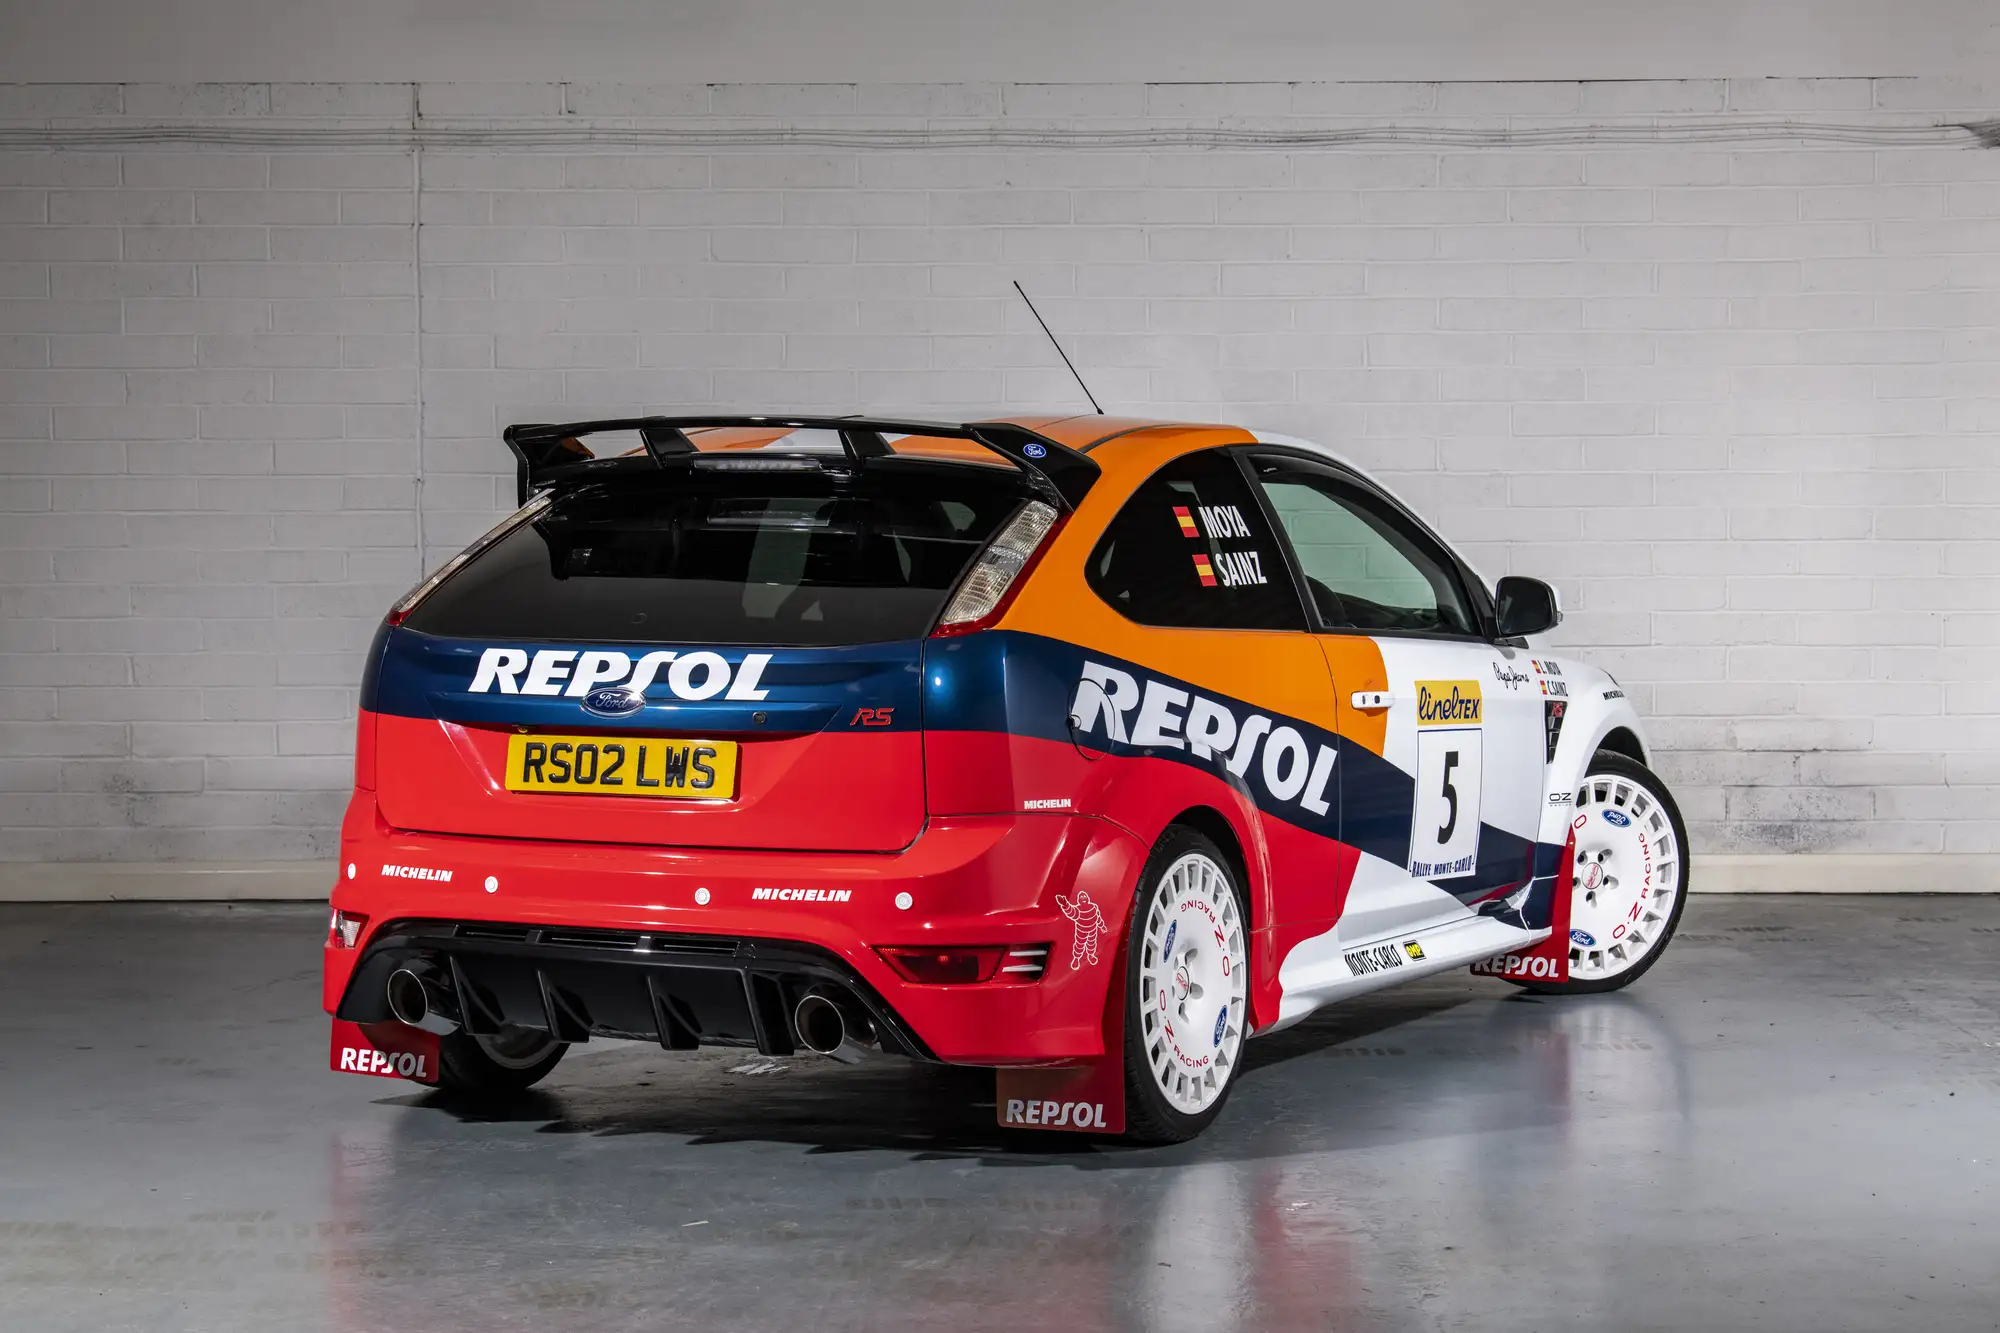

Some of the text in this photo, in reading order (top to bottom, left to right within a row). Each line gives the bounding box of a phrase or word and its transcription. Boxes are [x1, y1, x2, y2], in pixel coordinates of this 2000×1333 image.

[1198, 505, 1251, 538] MOYA
[1215, 551, 1268, 587] SAINZ
[468, 647, 773, 701] REPSOL
[595, 691, 631, 709] Ford
[850, 708, 895, 726] RS
[1071, 660, 1338, 817] REPSOL
[522, 742, 716, 789] RS02 LWS
[1024, 798, 1071, 810] MICHELIN
[1437, 751, 1459, 844] 5
[381, 865, 453, 882] MICHELIN
[1412, 855, 1472, 877] RALLYE MONTE-CARLO
[1638, 833, 1651, 899] RACING
[752, 887, 852, 902] MICHELIN
[1181, 900, 1216, 923] RACING
[1344, 944, 1403, 976] MONTE-CARLO
[340, 1047, 427, 1078] REPSOL
[1173, 1044, 1209, 1068] RACING
[1006, 1099, 1107, 1128] REPSOL
